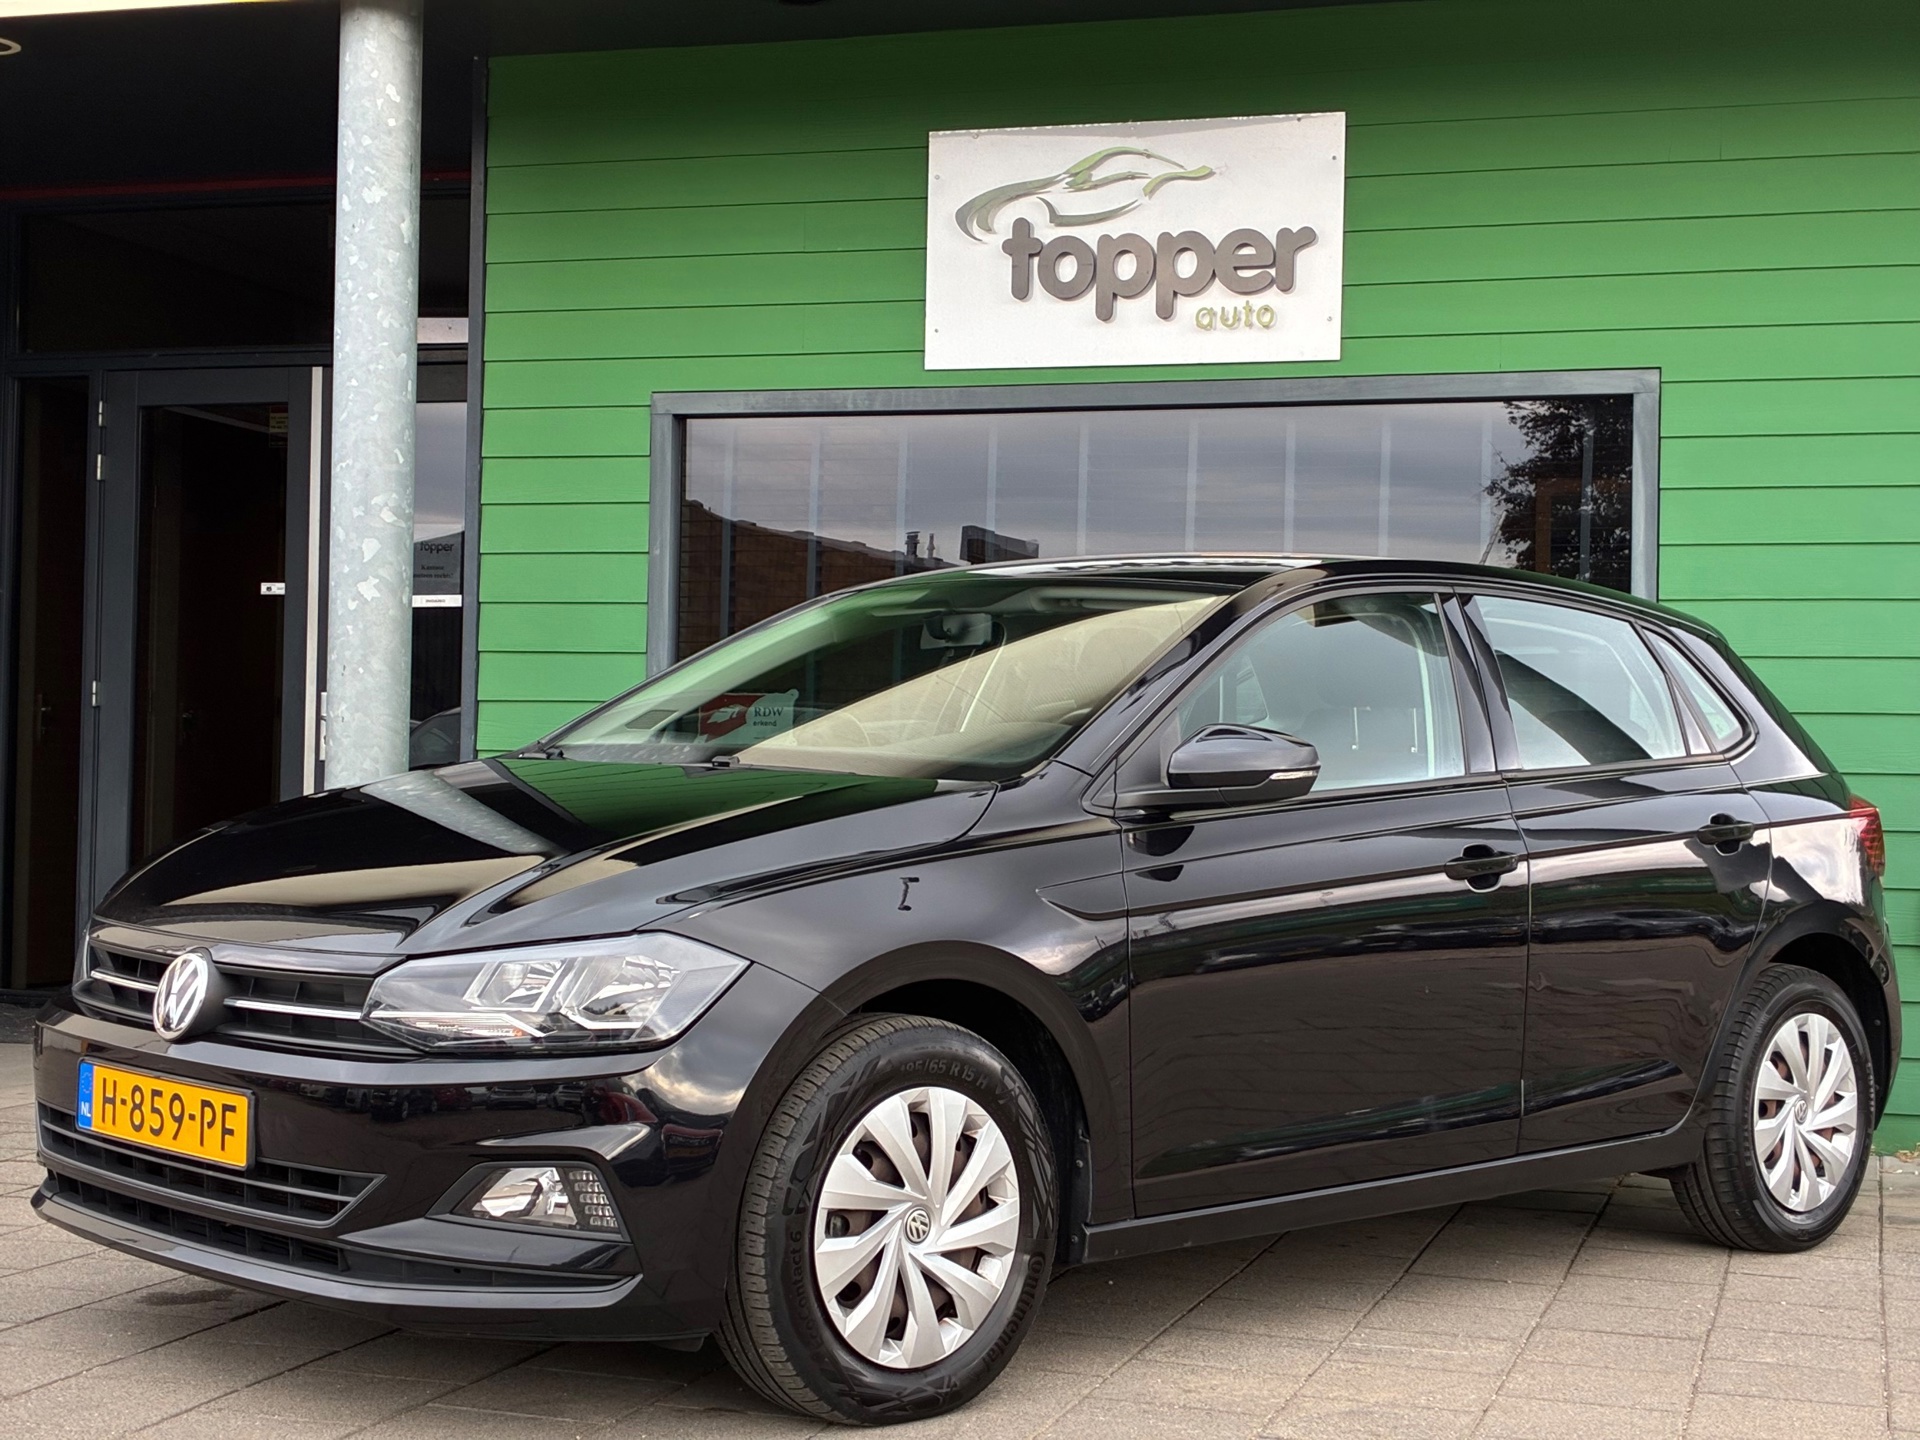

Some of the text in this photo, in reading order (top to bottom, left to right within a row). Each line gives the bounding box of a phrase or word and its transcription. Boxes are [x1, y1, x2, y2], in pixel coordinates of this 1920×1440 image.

[1001, 217, 1318, 322] topper
[1195, 300, 1275, 330] auto
[754, 707, 784, 717] RDW
[80, 1101, 91, 1118] NL
[102, 1077, 237, 1152] H-859-PF
